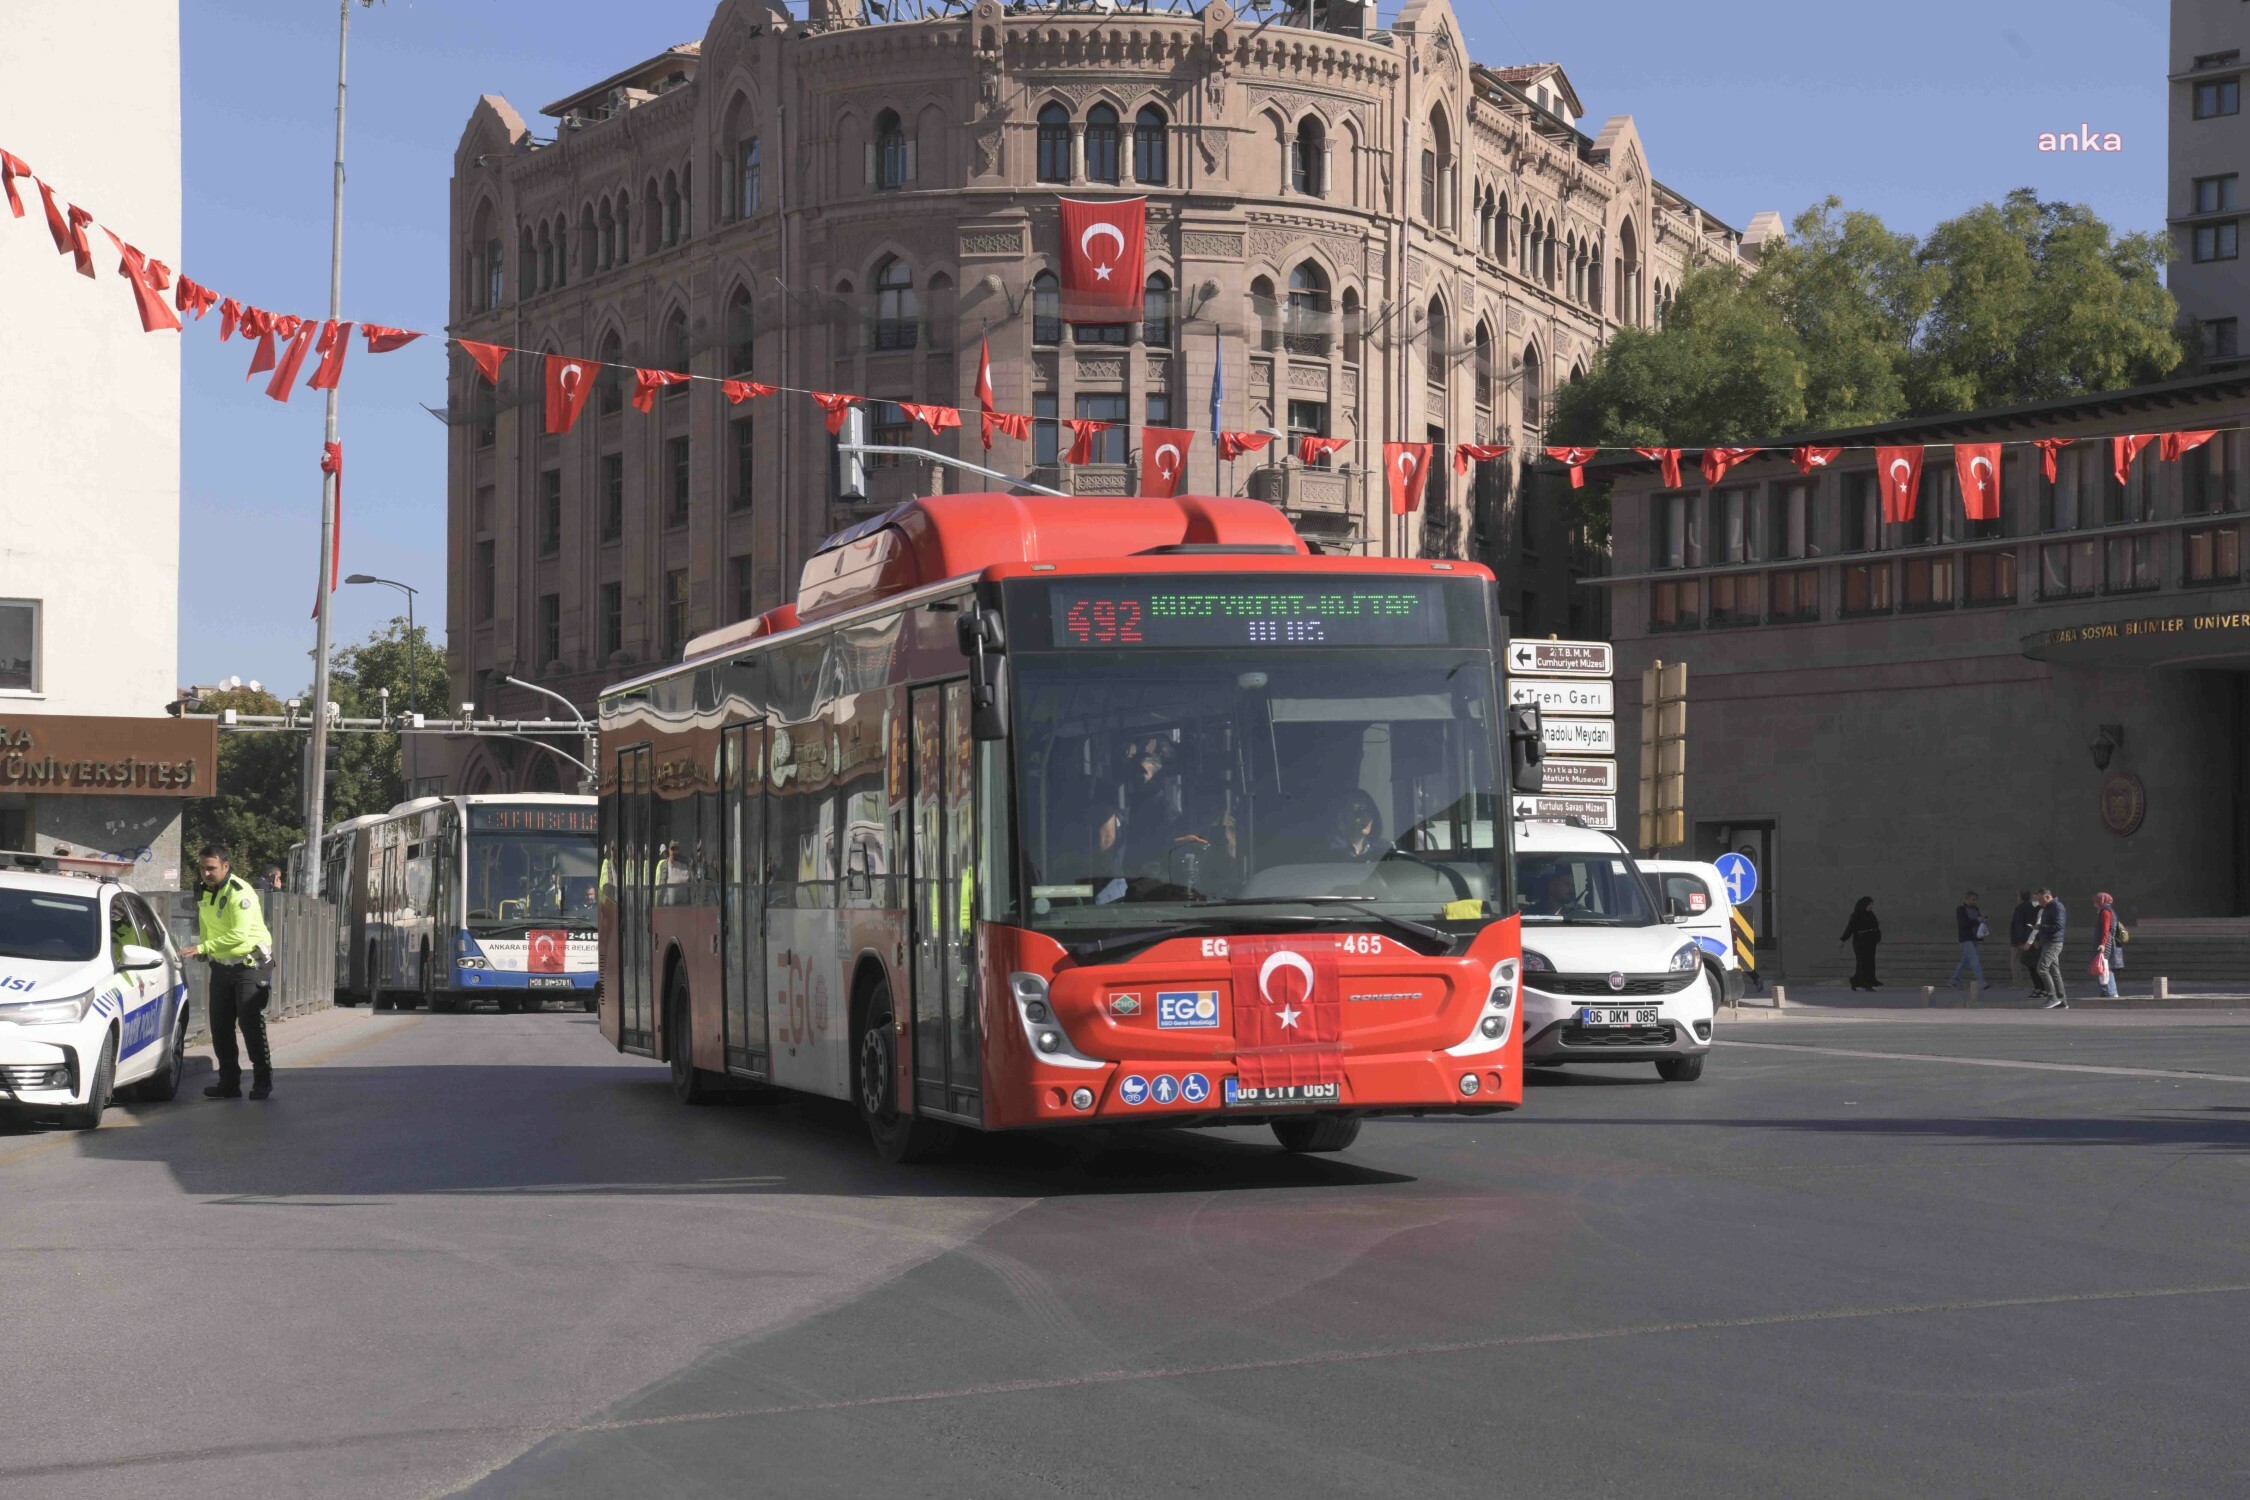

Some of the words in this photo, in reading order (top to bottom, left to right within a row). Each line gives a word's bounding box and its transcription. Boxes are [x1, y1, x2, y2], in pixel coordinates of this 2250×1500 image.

[1068, 601, 1142, 641] 492
[2082, 624, 2119, 640] SOSYAL
[1537, 657, 1579, 669] Cumhuriyet
[1580, 659, 1605, 668] Müzesi
[1526, 689, 1562, 703] Tren
[1569, 689, 1601, 704] Garı
[1575, 725, 1609, 747] Meydanı
[6, 752, 197, 783] ÜNİVERSİTESİ
[1538, 801, 1564, 812] Kurtuluş
[1585, 802, 1606, 813] Müzesi
[1692, 895, 1703, 904] 112
[489, 943, 521, 951] ANKARA
[1202, 938, 1229, 957] EG
[1116, 1000, 1134, 1009] CNG
[1161, 999, 1216, 1020] EGO
[1590, 1010, 1602, 1023] 06
[1609, 1010, 1629, 1023] DKM
[1636, 1009, 1656, 1023] 085
